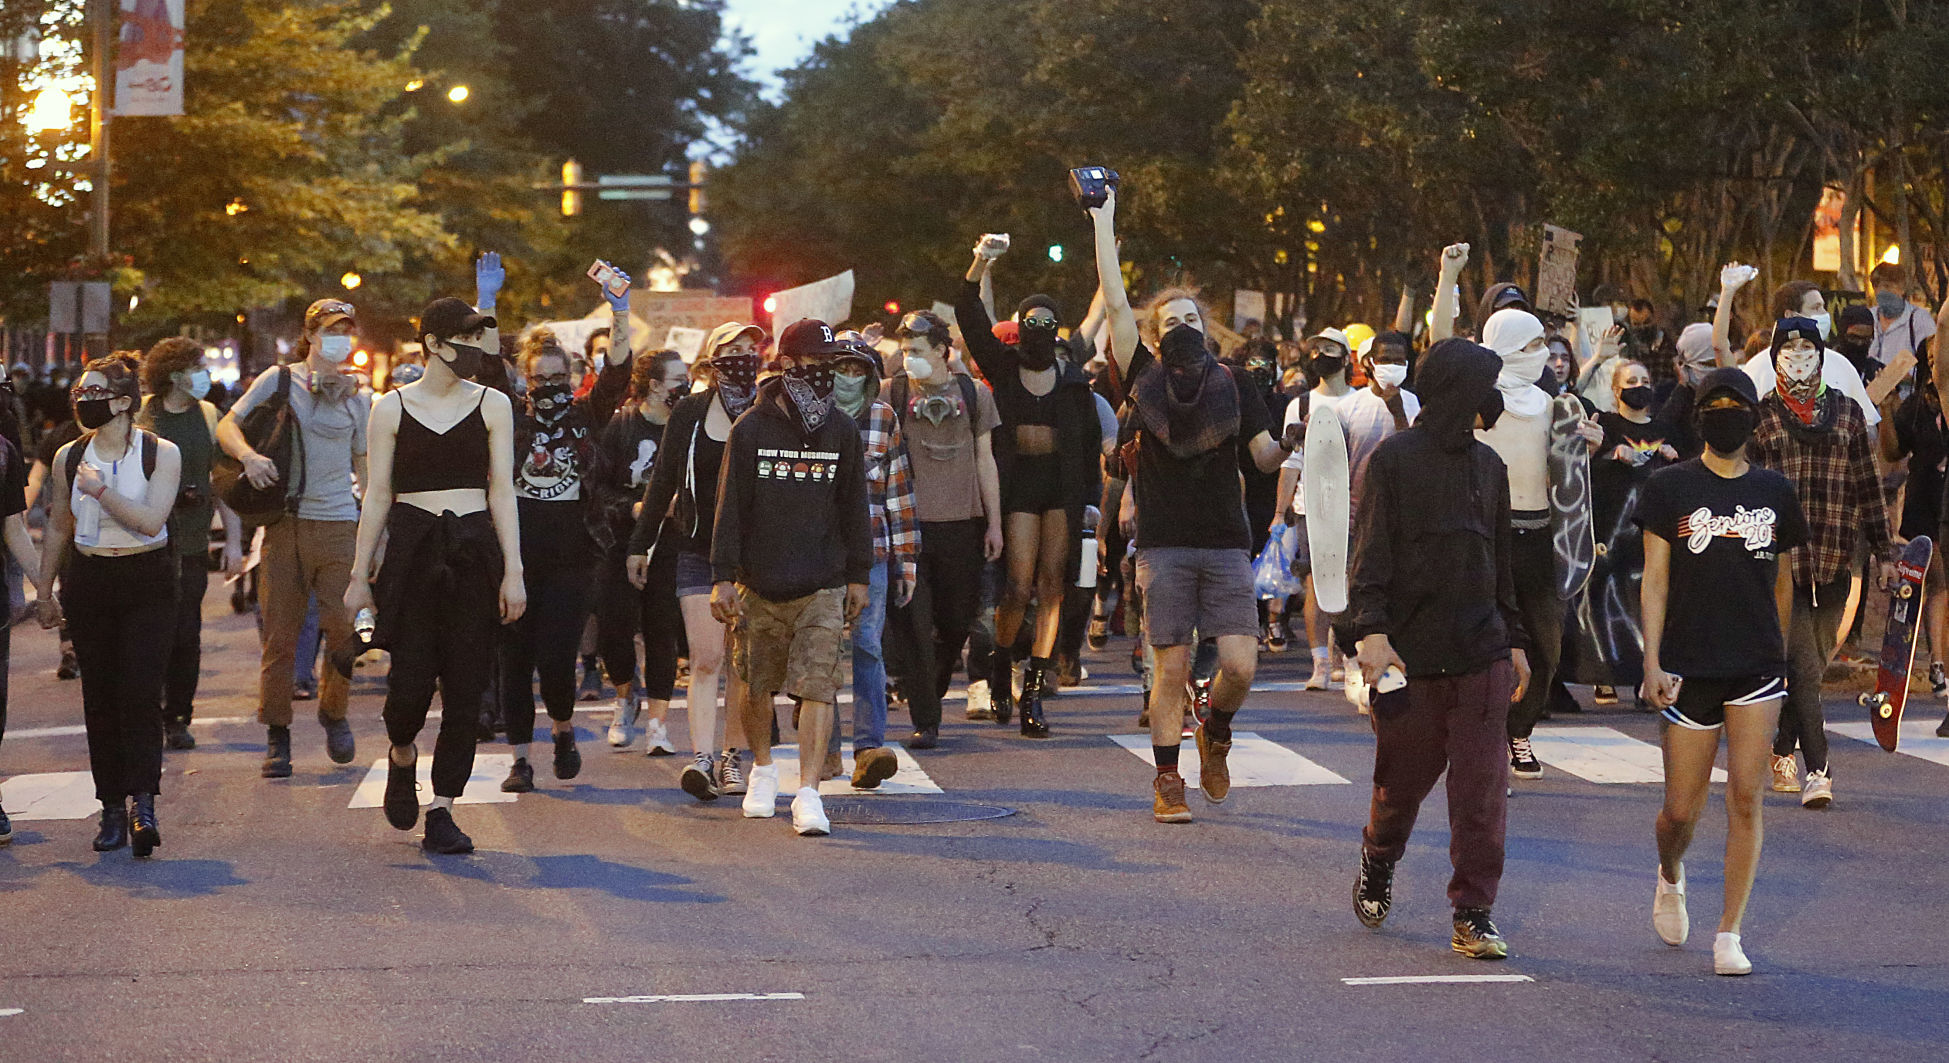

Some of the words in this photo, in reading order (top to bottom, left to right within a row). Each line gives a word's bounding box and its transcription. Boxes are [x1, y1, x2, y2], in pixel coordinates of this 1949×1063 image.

[820, 325, 833, 343] B
[758, 449, 778, 457] KNOW
[780, 450, 799, 458] YOUR
[1688, 504, 1777, 555] Seniors
[1896, 560, 1924, 580] Supreme
